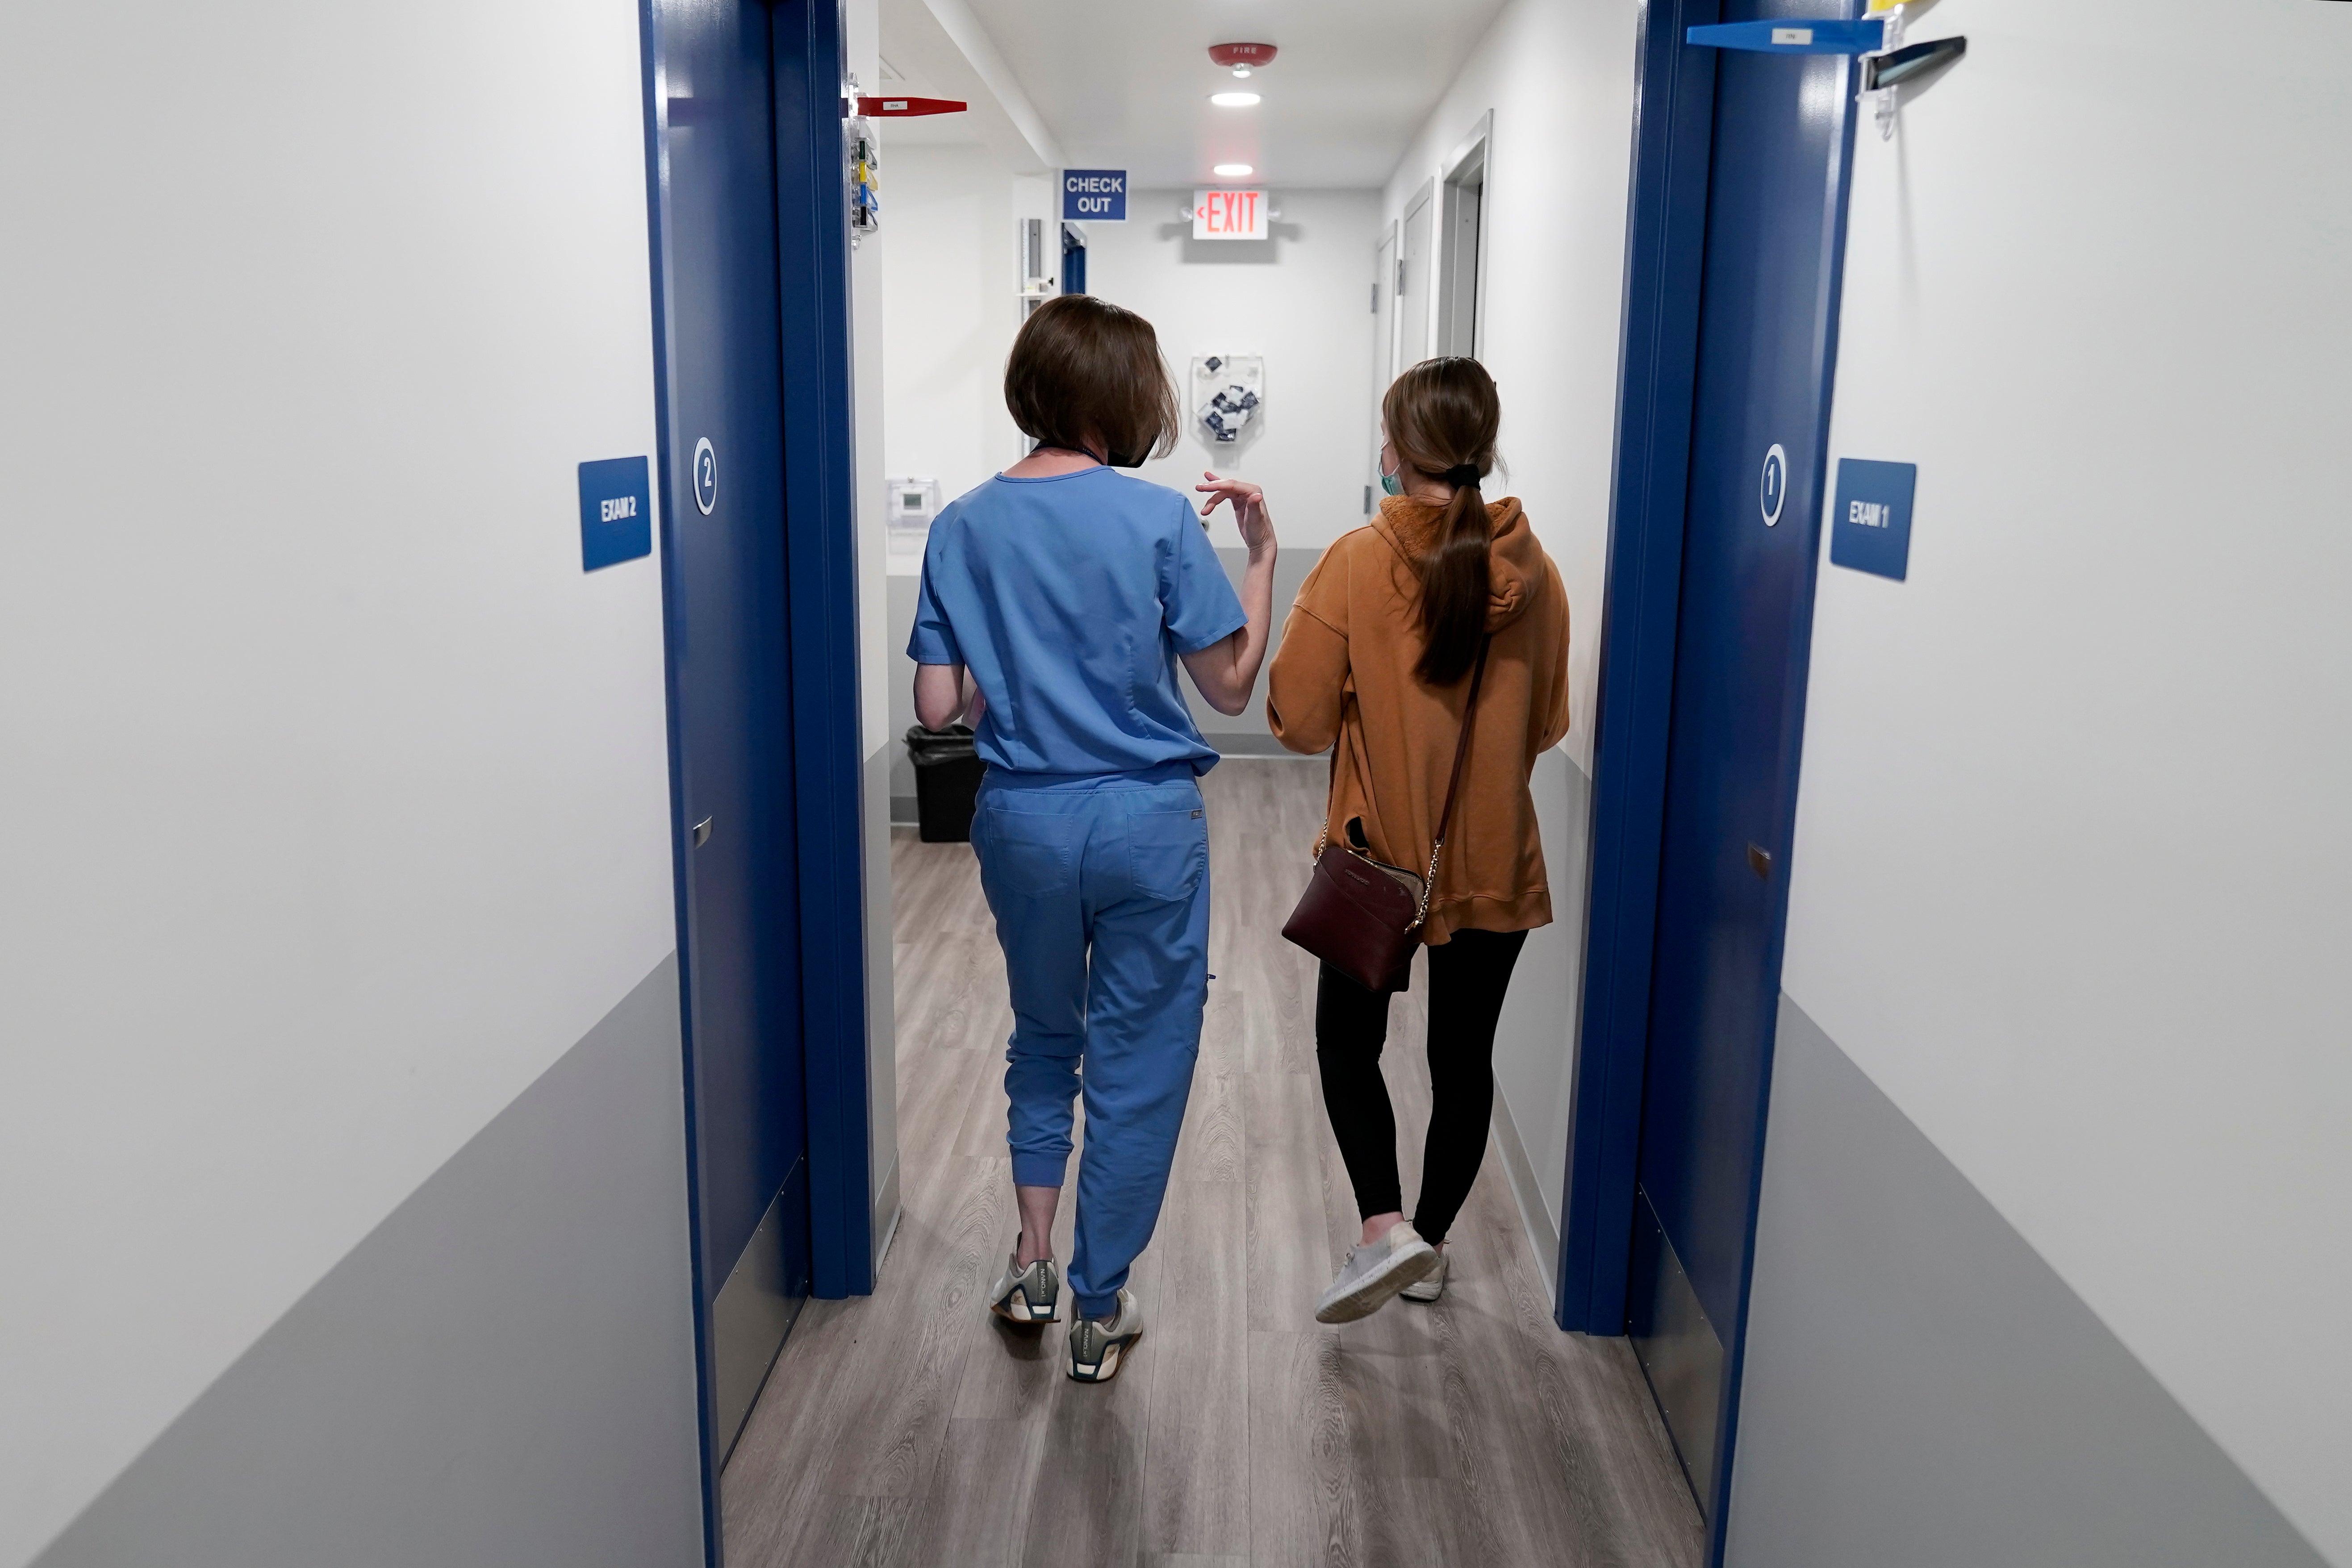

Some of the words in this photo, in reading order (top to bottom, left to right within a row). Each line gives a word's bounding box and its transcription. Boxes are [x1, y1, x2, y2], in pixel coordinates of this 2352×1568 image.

[1066, 177, 1123, 193] CHECK
[1078, 197, 1112, 213] OUT
[1207, 192, 1258, 232] EXIT
[704, 457, 712, 487] 2
[1768, 464, 1775, 496] 1
[601, 496, 629, 522] EXAM
[629, 496, 637, 517] 2
[1849, 500, 1881, 528] EXAM
[1881, 505, 1890, 529] 1
